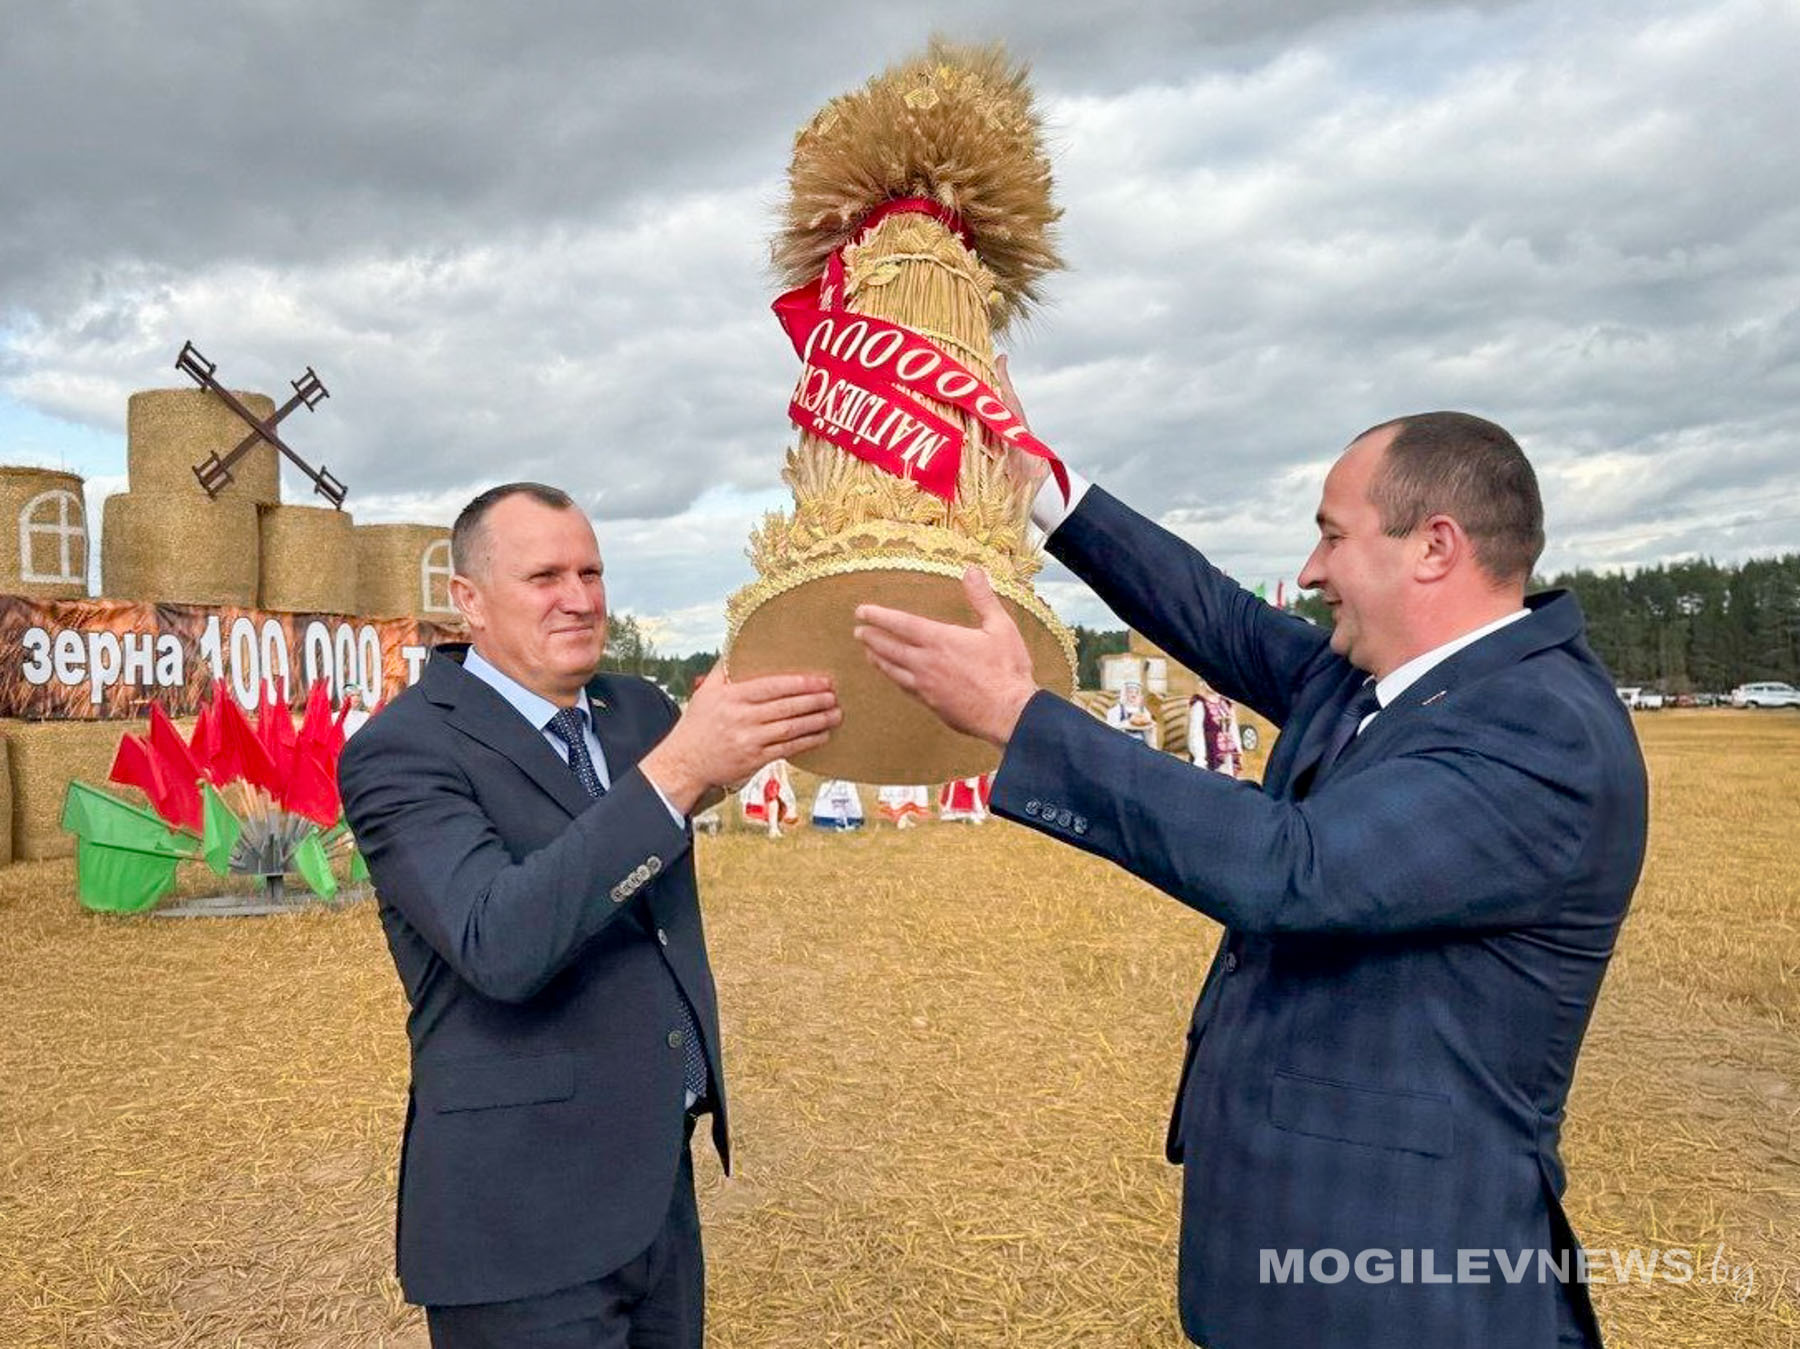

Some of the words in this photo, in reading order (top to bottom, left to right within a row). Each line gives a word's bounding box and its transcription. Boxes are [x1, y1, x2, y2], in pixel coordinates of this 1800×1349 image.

[22, 626, 184, 704] зерна
[200, 615, 290, 710] 100
[305, 620, 383, 707] 000
[402, 645, 432, 687] т
